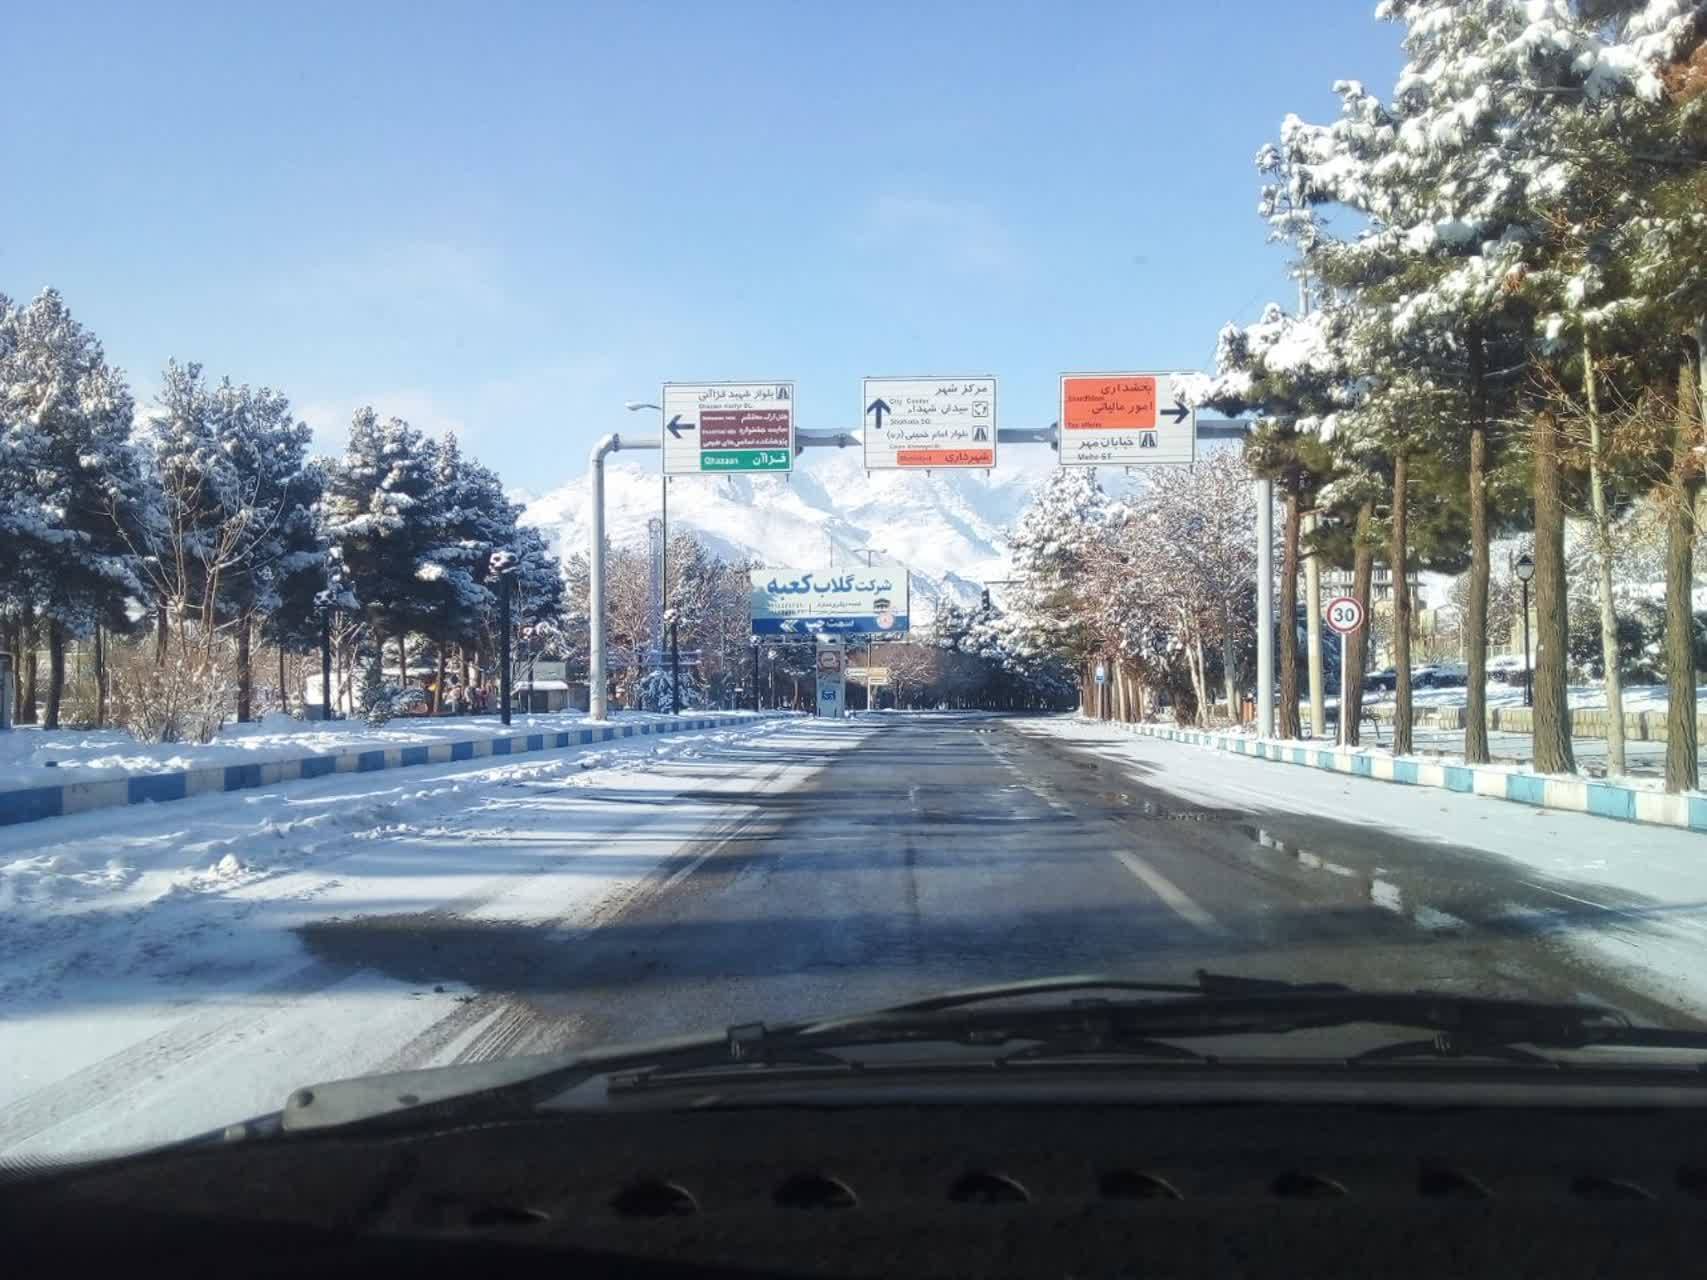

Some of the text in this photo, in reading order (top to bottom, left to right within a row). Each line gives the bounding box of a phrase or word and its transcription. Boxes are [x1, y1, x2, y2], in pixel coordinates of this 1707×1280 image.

[753, 389, 774, 400] بلوار
[935, 384, 988, 396] مرکز شهر
[1100, 383, 1152, 396] بخشداری
[941, 404, 969, 415] میدان
[1091, 400, 1153, 416] امور مالیاتی
[931, 430, 948, 440] امام
[1078, 436, 1134, 450] خیابان مهر
[944, 451, 989, 464] شهرداری
[766, 573, 893, 600] شرکت گلاب کعبه
[1334, 607, 1355, 622] 30
